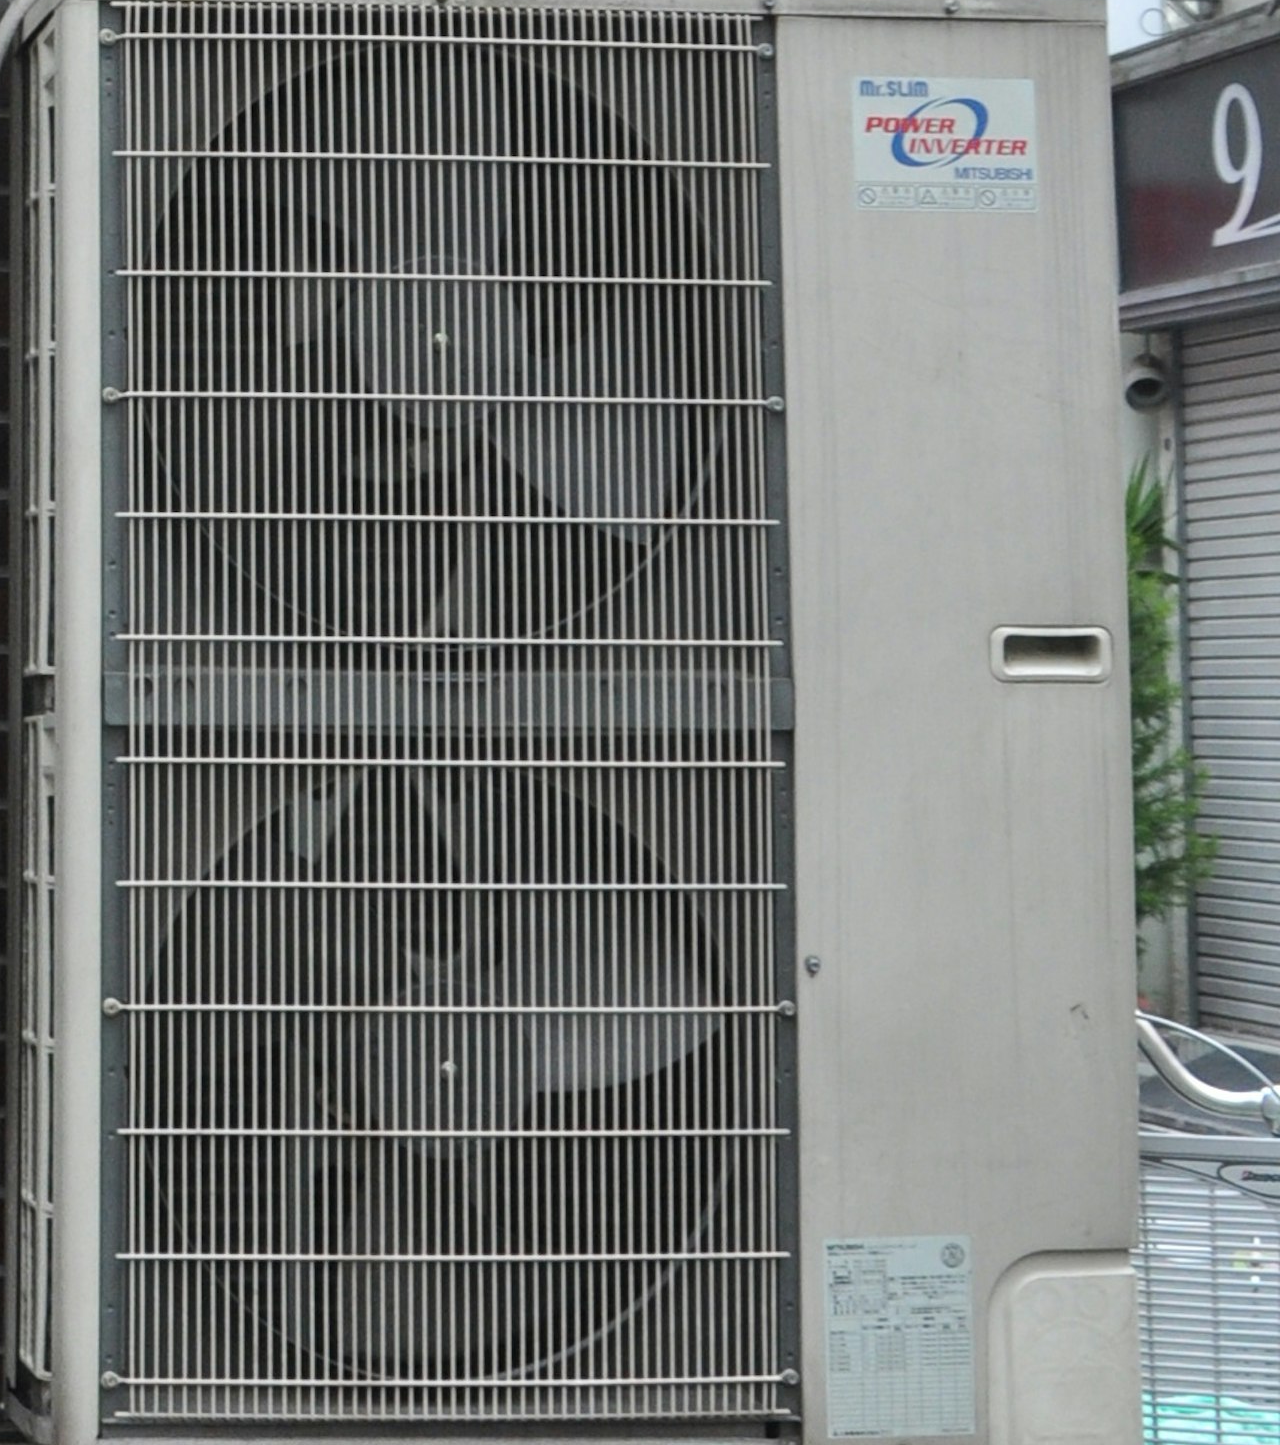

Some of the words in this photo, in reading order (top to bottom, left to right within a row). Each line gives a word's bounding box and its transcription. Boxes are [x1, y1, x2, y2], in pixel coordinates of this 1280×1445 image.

[865, 117, 956, 134] POWER
[909, 138, 1028, 155] INVERTER
[954, 166, 1034, 181] MITSUBISHI
